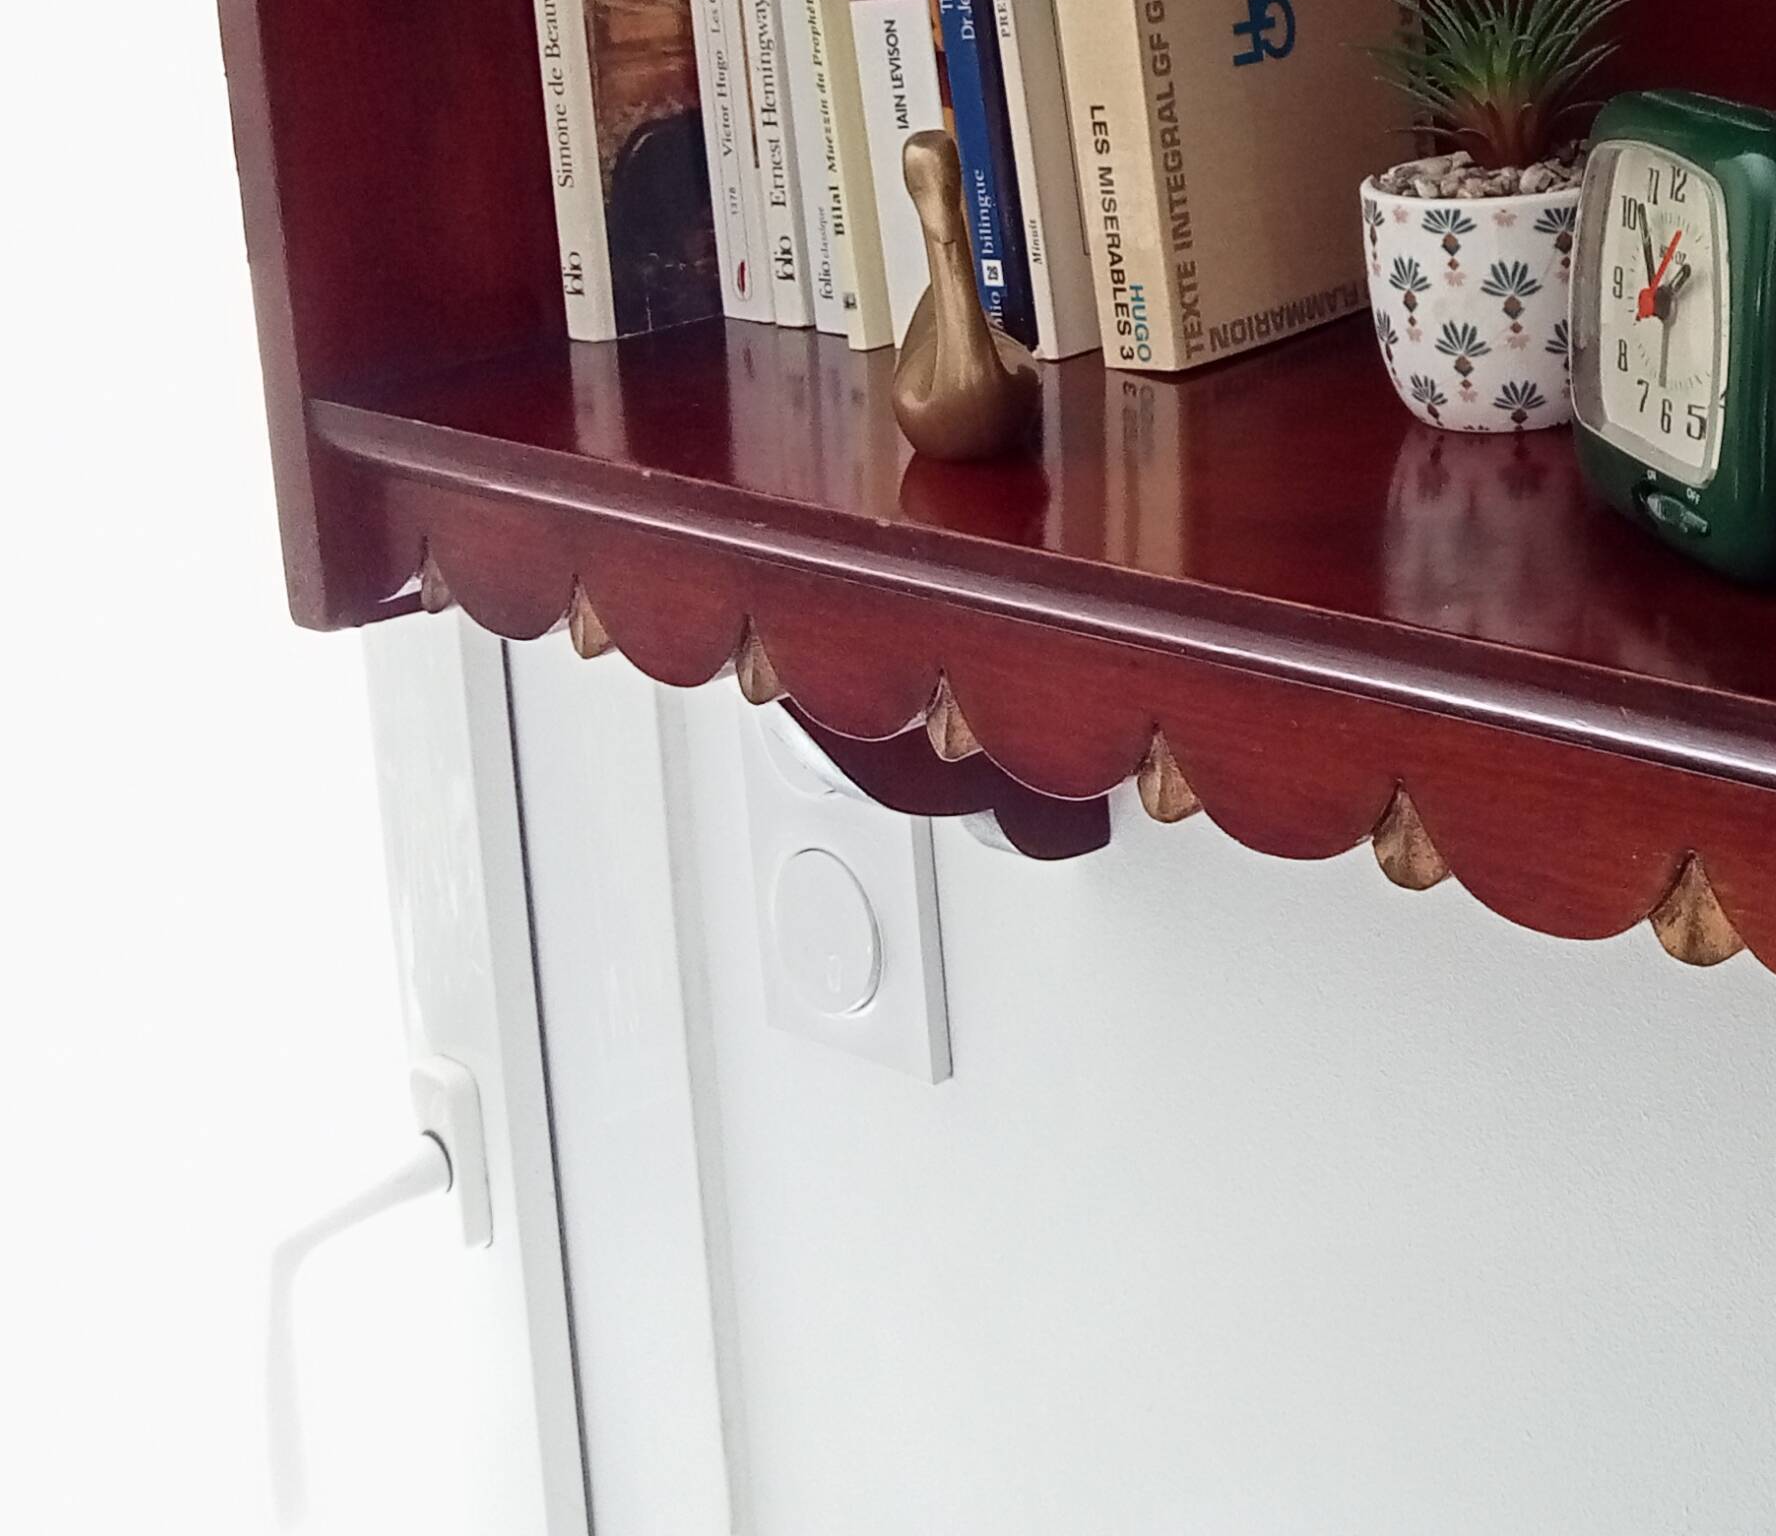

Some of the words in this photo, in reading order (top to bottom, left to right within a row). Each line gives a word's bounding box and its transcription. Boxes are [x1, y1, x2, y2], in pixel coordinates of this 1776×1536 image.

[711, 9, 722, 34] Les
[961, 17, 976, 41] Dr
[714, 50, 729, 98] Hugo
[883, 19, 903, 90] LEVISON
[1144, 32, 1174, 77] GF
[547, 67, 565, 96] de
[814, 71, 827, 93] du
[719, 104, 734, 158] Victor
[892, 93, 910, 130] IAIN
[1089, 104, 1111, 155] LES
[557, 104, 576, 189] Simone
[817, 98, 838, 174] Muezzin
[766, 137, 787, 208] Ernest
[1154, 81, 1196, 254] INTEGRAL
[1646, 167, 1660, 206] 11
[1670, 165, 1689, 203] 12
[828, 184, 846, 236] Bilal
[973, 168, 995, 255] bilingue
[1621, 195, 1638, 232] 10
[773, 235, 796, 283] folio
[1027, 218, 1043, 265] Minuit
[1097, 166, 1133, 328] MISERABLES
[564, 250, 585, 297] folio
[818, 259, 834, 301] folio
[1612, 266, 1624, 299] 9
[990, 291, 1004, 331] olio
[1129, 283, 1153, 363] HUGO
[1177, 261, 1205, 360] TEXTE
[1208, 283, 1359, 353] FLAMMARION
[1119, 343, 1134, 361] 3
[1617, 339, 1629, 372] 8
[1637, 379, 1650, 413] 7
[1660, 398, 1673, 434] 6
[1686, 405, 1708, 441] 5
